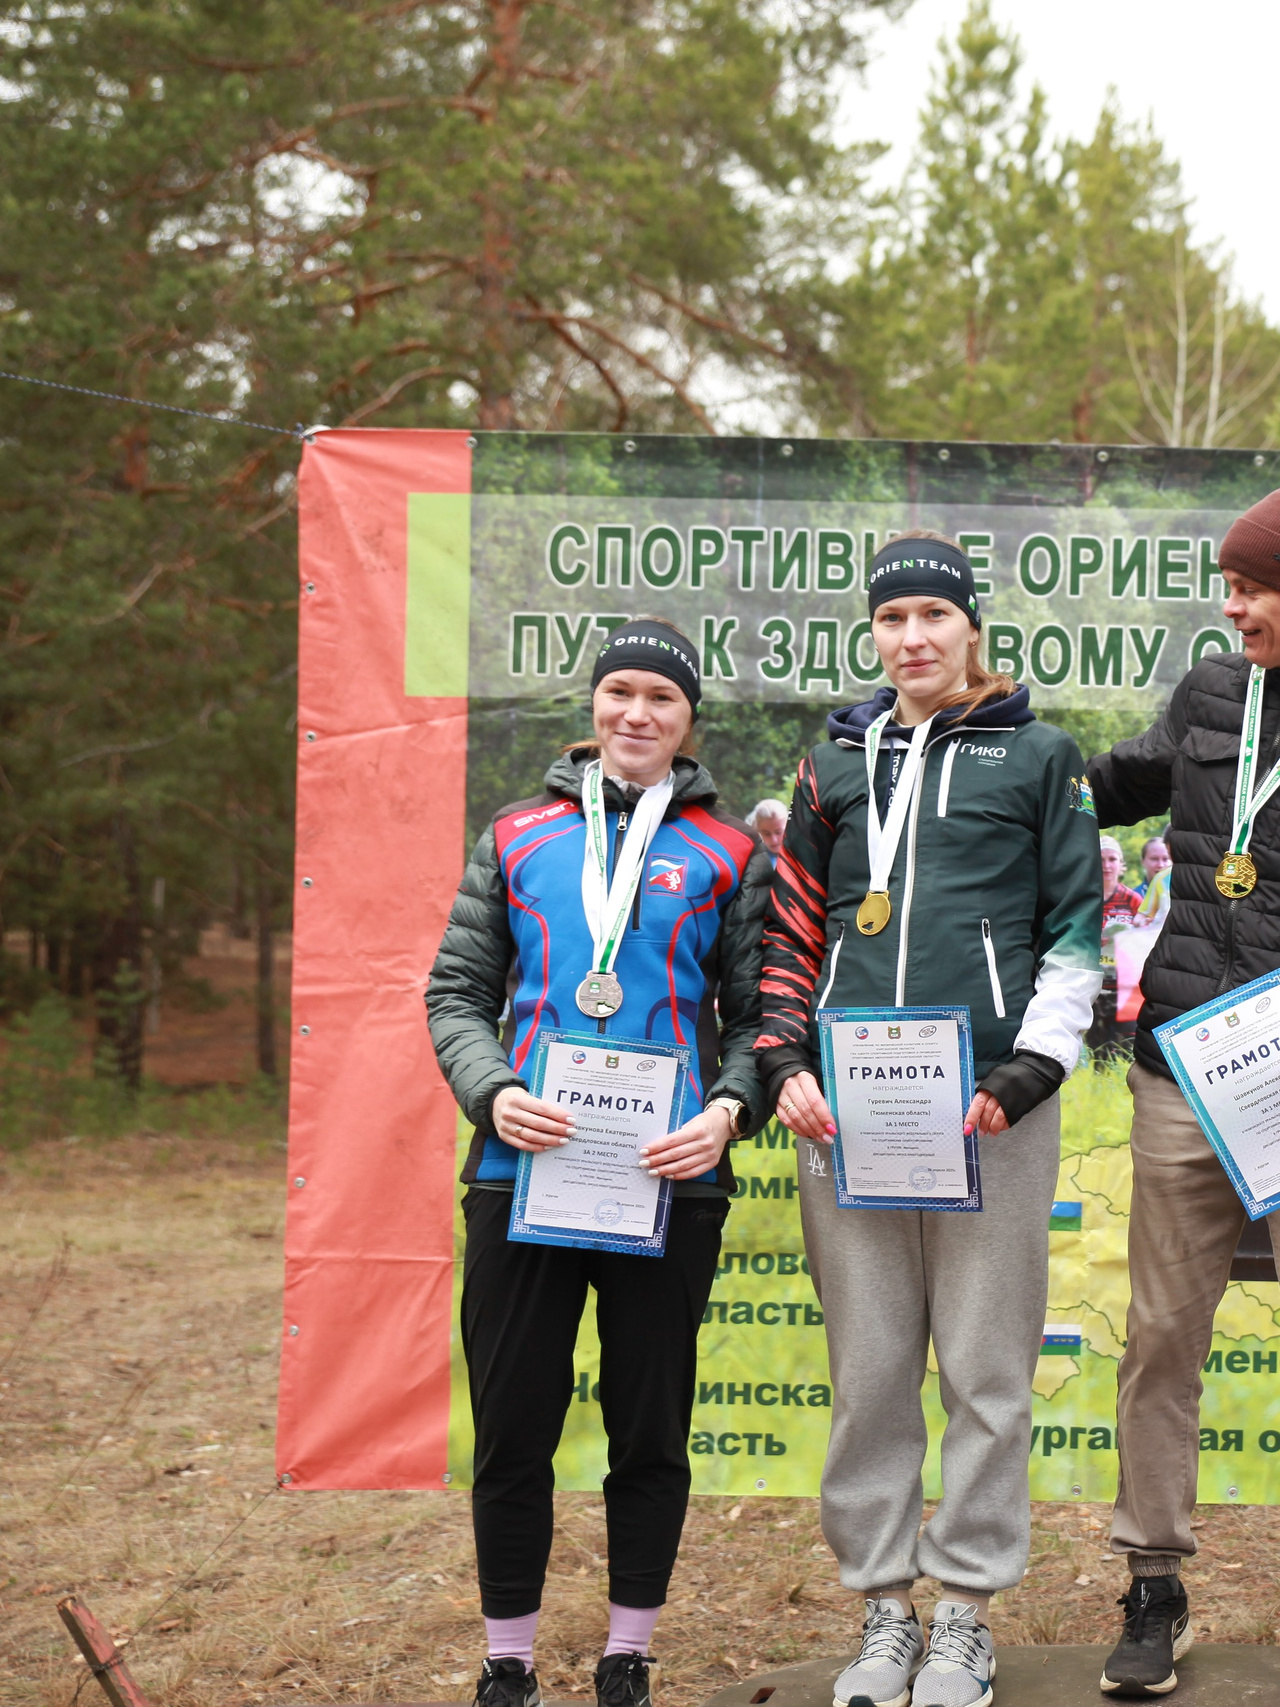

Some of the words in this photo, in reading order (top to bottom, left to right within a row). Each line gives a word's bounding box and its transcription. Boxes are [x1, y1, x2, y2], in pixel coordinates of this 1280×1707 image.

[869, 558, 961, 584] ORIENTEAM
[704, 618, 738, 678] К
[761, 618, 1166, 691] ЗДОВОМУ
[960, 743, 1007, 758] ГИКО
[849, 1065, 945, 1079] ГРАМОТА
[557, 1089, 655, 1114] ГРАМОТА
[578, 1112, 631, 1123] награждается
[573, 1125, 604, 1134] авкунова
[605, 1128, 639, 1138] Екатерина
[597, 1151, 618, 1159] МЕСТО
[701, 1301, 825, 1326] ласть
